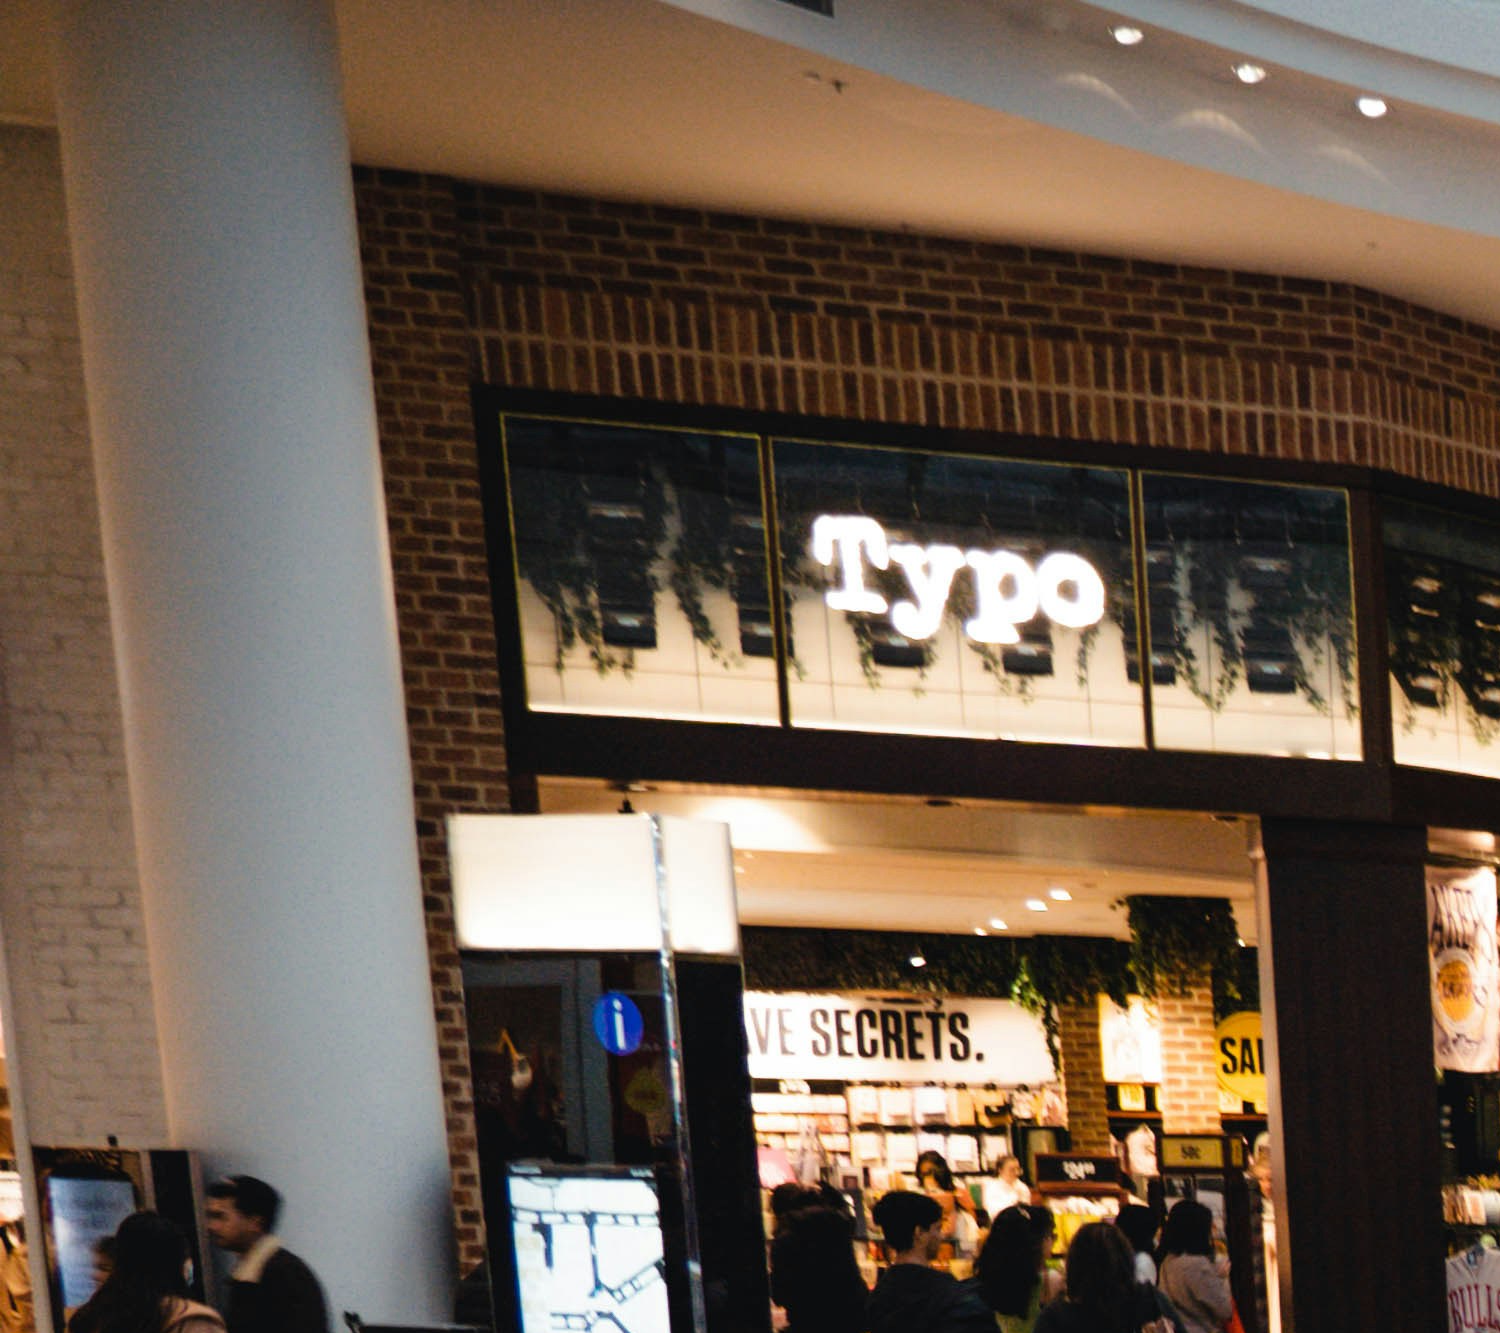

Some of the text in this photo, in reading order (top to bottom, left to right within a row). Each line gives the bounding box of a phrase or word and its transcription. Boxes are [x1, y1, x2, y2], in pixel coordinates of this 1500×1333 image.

[811, 514, 1105, 644] Typo
[748, 1007, 984, 1062] VE SECRETS.
